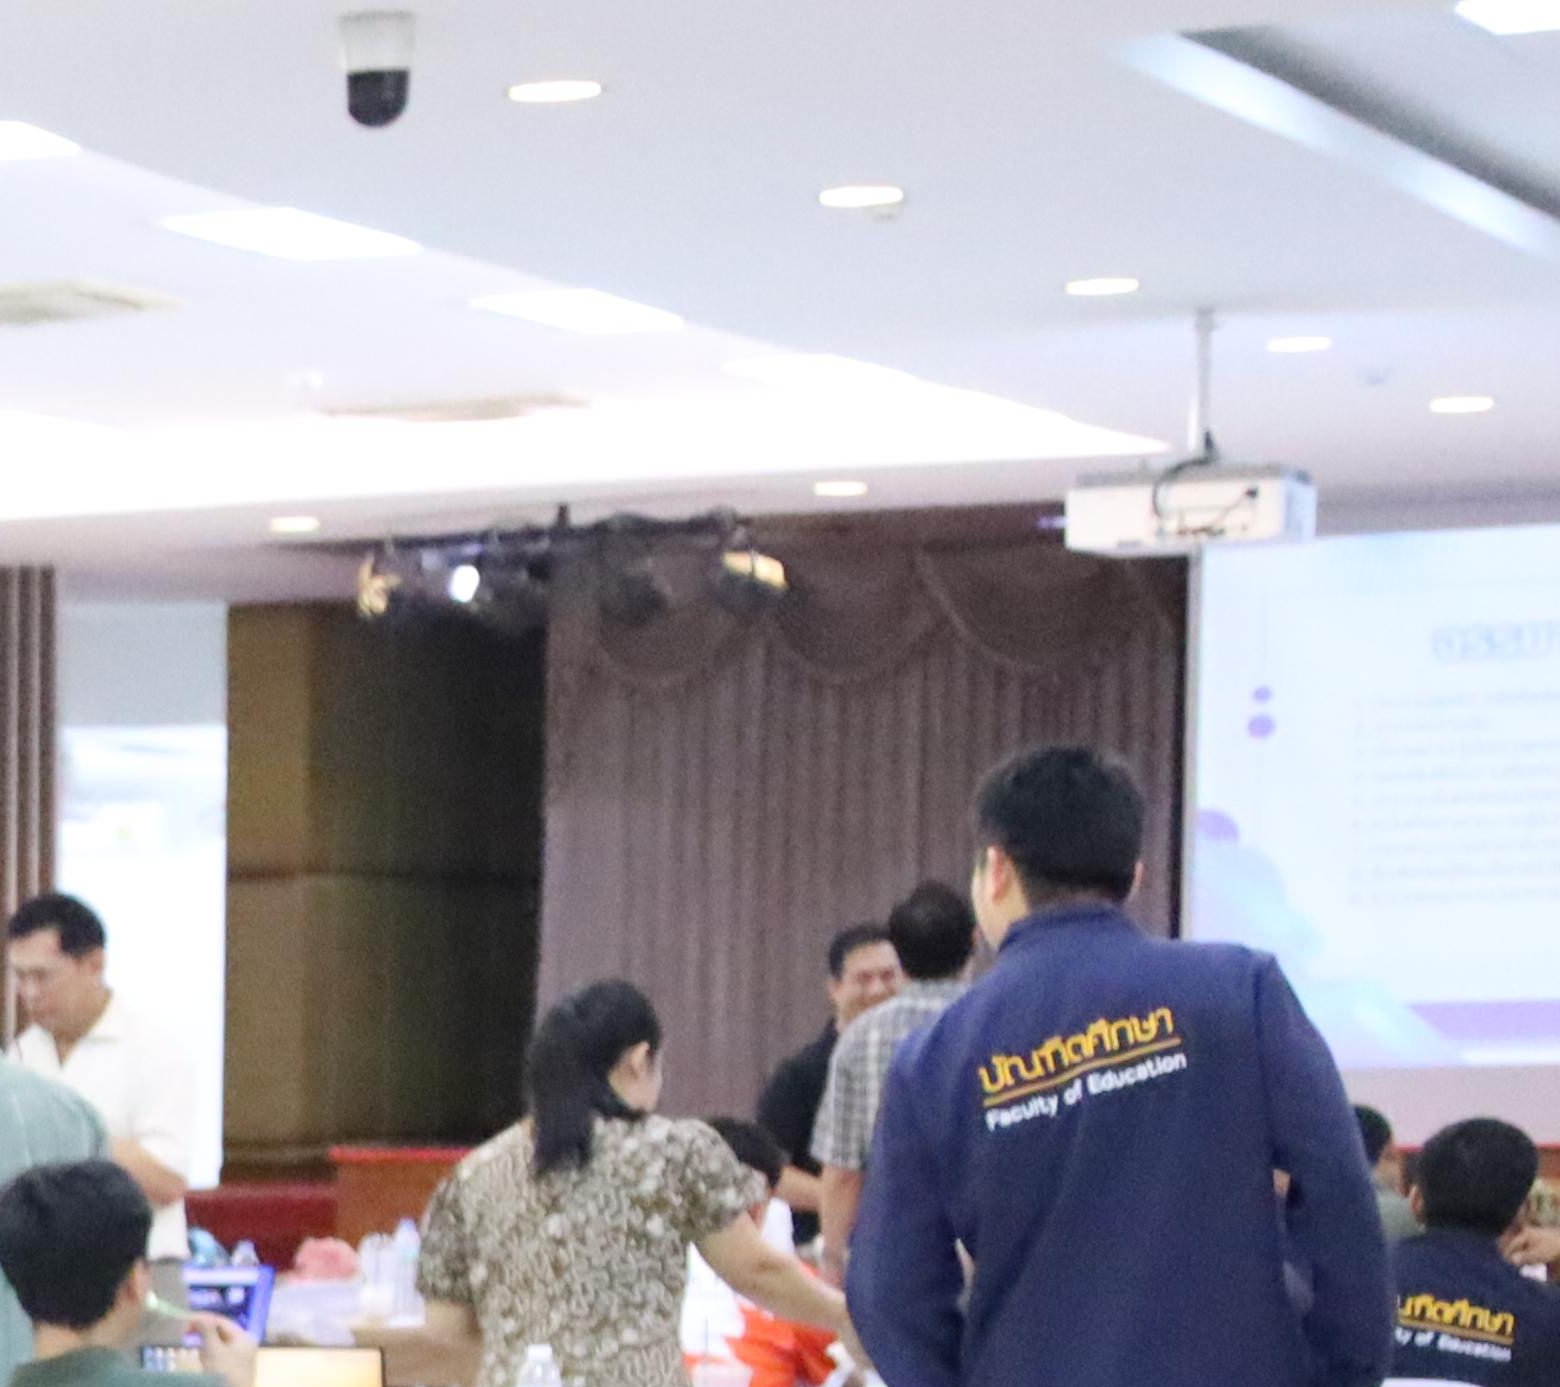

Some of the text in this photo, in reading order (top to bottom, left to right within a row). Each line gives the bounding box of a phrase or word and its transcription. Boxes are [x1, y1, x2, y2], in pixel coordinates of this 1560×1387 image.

[985, 1052, 1187, 1132] Faculty of Education
